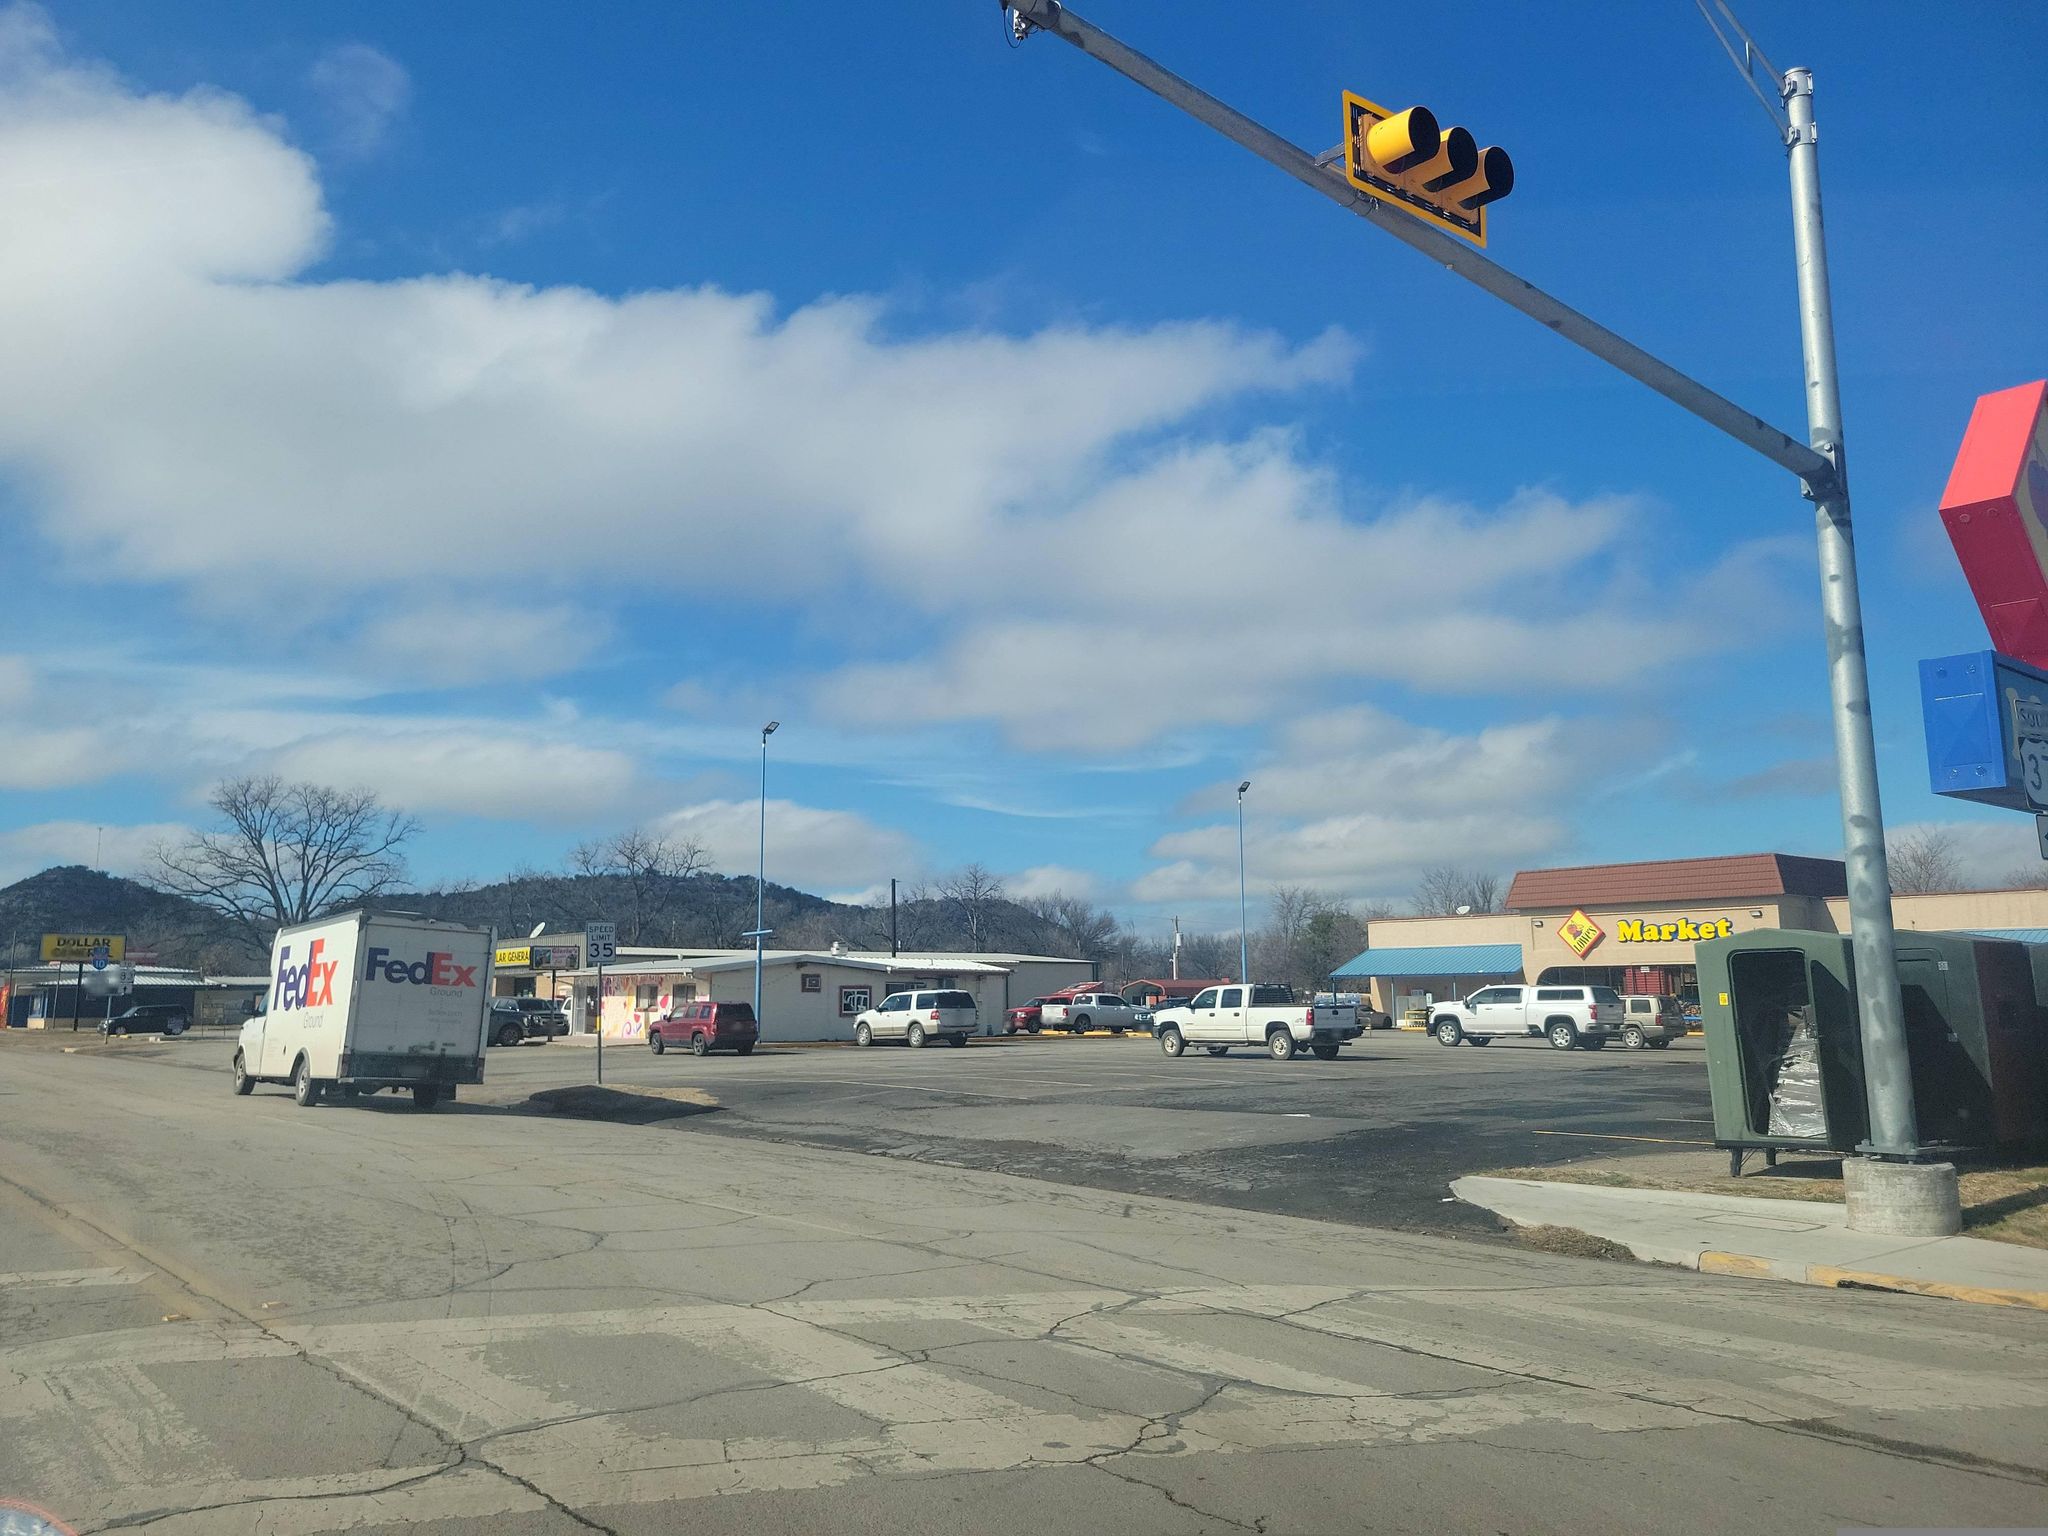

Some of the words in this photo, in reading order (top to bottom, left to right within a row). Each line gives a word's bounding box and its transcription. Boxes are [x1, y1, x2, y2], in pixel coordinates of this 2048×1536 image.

[588, 925, 614, 933] SPEED
[1617, 918, 1733, 942] Market
[56, 937, 111, 947] DOLLAR
[589, 942, 614, 958] 35
[95, 960, 105, 968] 10
[365, 947, 478, 987] FedEx
[273, 938, 339, 1011] FedEx
[429, 986, 463, 998] Ground
[303, 1013, 324, 1029] Ground
